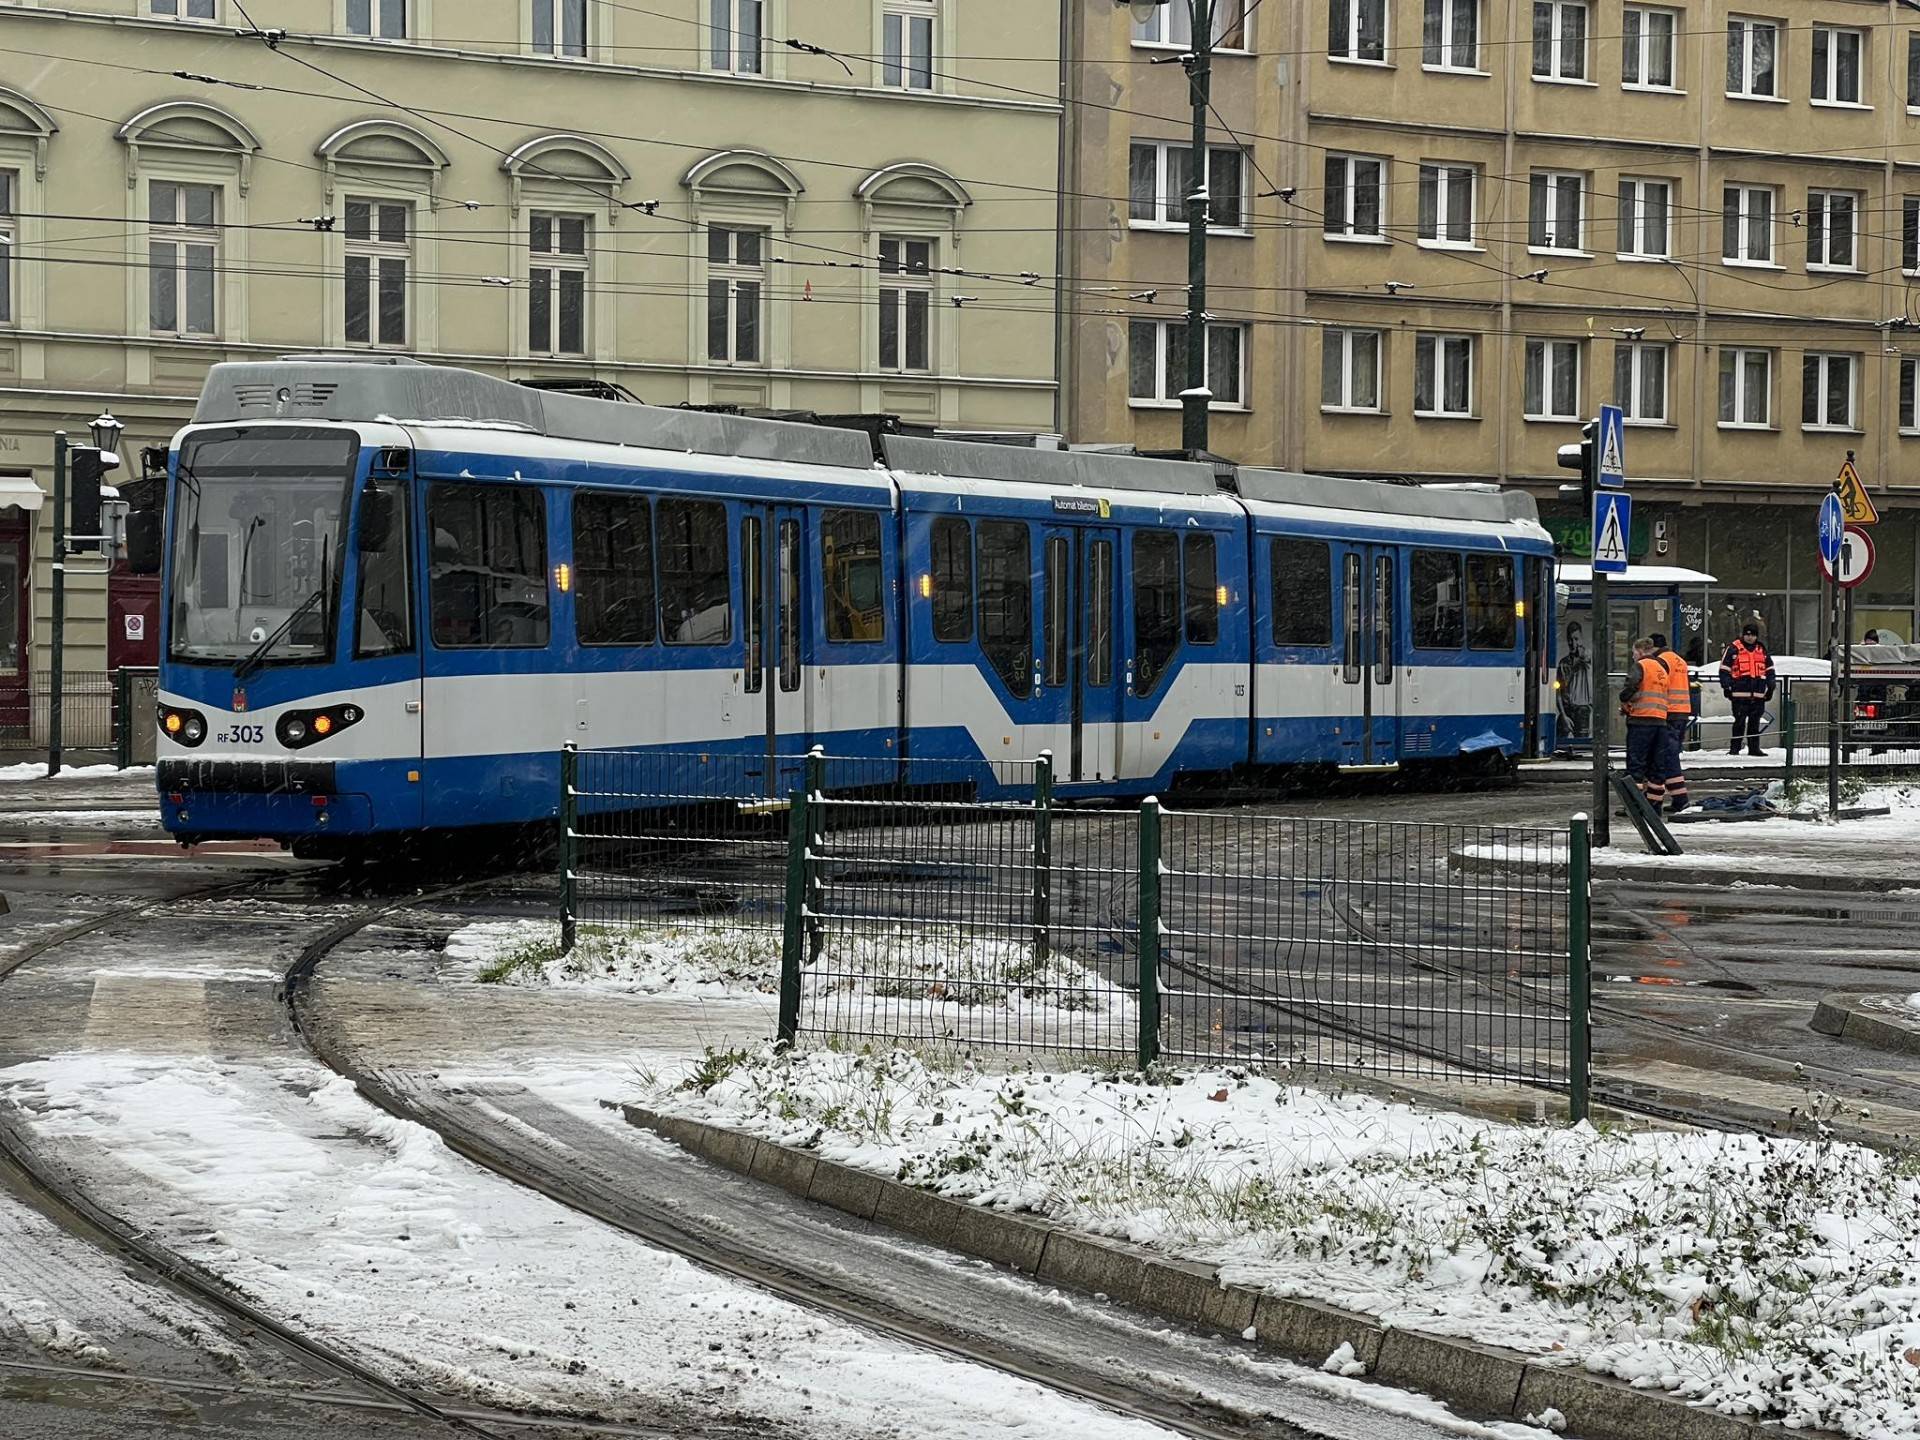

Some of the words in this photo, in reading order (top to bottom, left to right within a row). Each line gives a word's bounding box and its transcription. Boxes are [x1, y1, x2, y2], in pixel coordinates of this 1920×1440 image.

[1055, 499, 1076, 510] Automat
[1077, 501, 1098, 514] biletowy
[230, 725, 264, 743] 303
